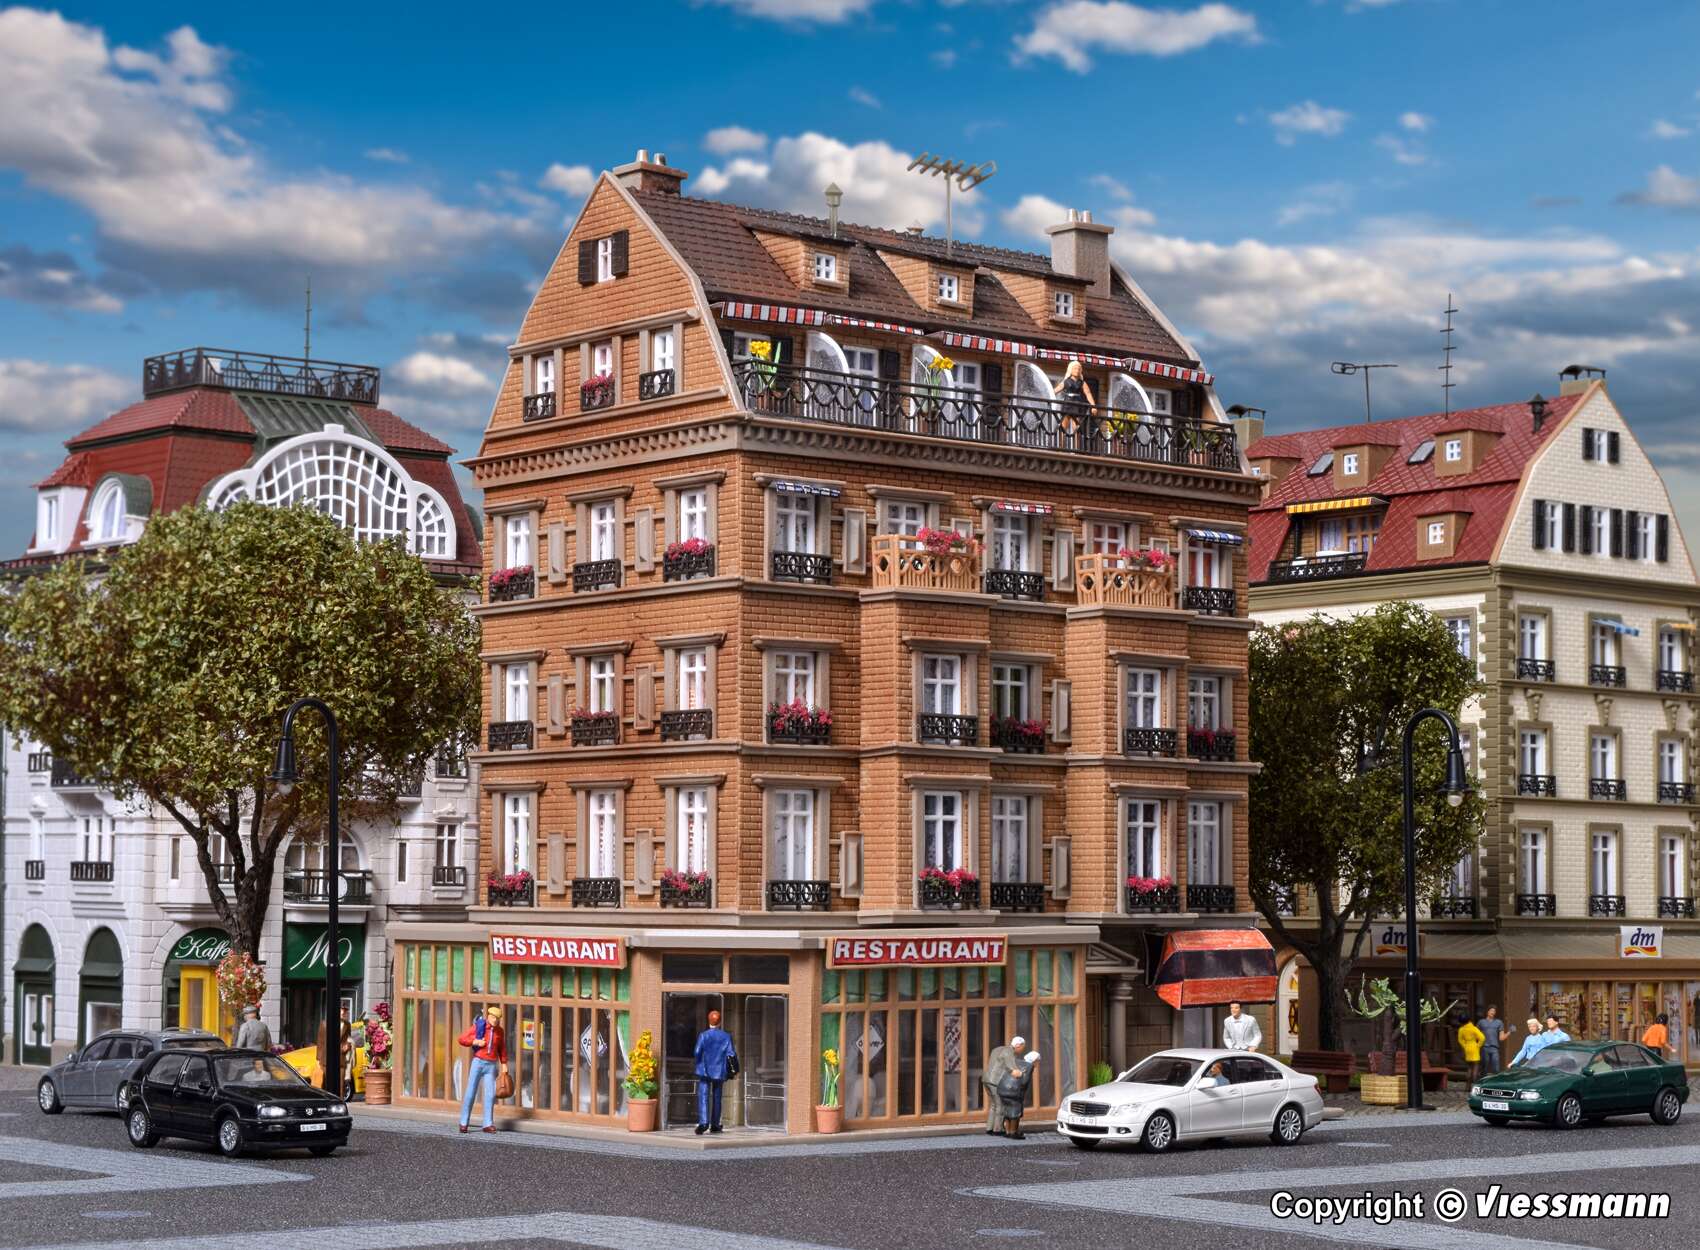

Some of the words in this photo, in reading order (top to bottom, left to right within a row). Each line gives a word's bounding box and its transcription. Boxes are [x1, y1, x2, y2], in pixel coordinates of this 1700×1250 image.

[1630, 927, 1656, 946] dm
[492, 936, 617, 960] RESTAURANT
[834, 940, 1003, 960] RESTAURANT
